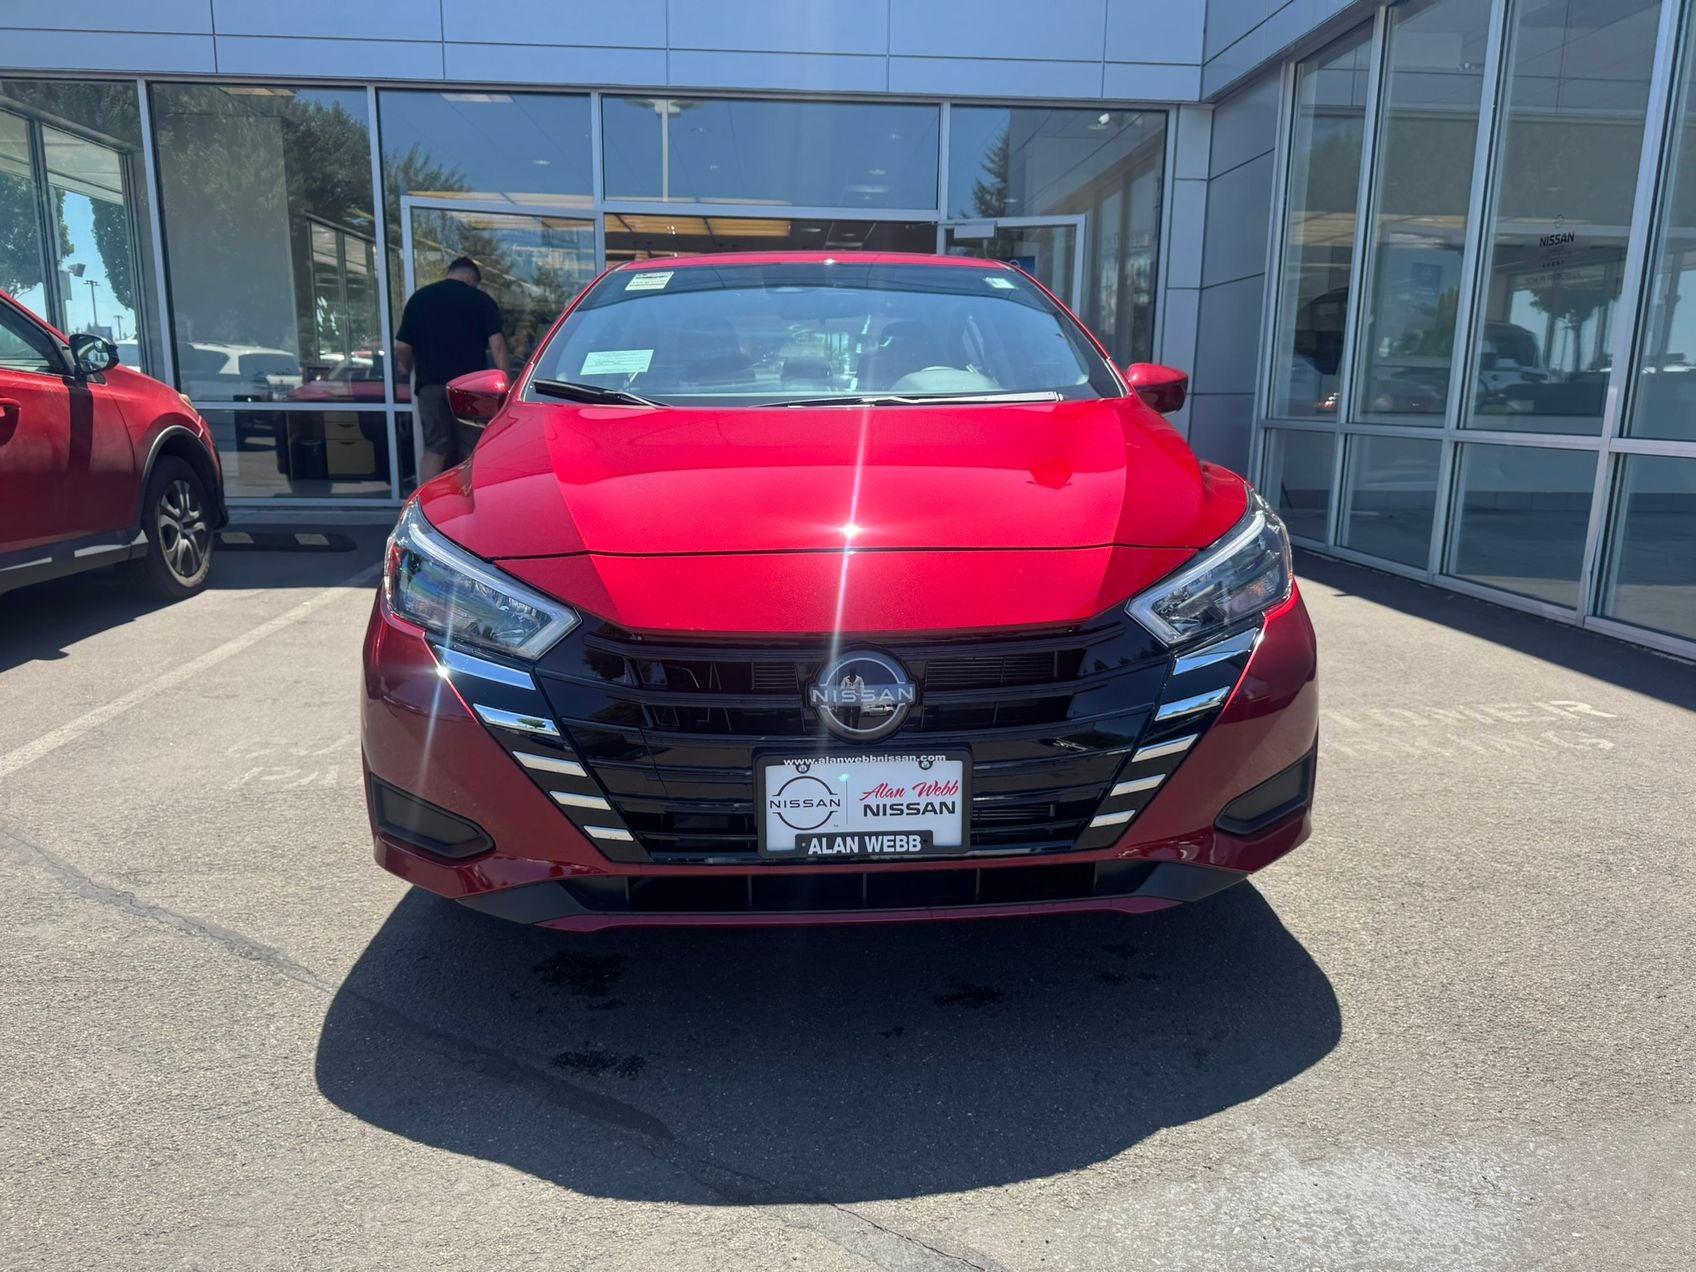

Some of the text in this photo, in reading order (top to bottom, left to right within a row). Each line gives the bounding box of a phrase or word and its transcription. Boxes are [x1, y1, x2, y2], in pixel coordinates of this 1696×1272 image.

[1538, 231, 1575, 247] NISSAN
[812, 687, 914, 703] NISSAN
[783, 754, 946, 767] www.alanwebbnissan.com
[860, 780, 959, 801] Alan Webb
[769, 798, 841, 809] NISSAN
[863, 801, 956, 817] NISSAN
[808, 834, 922, 855] ALAN WEBB
